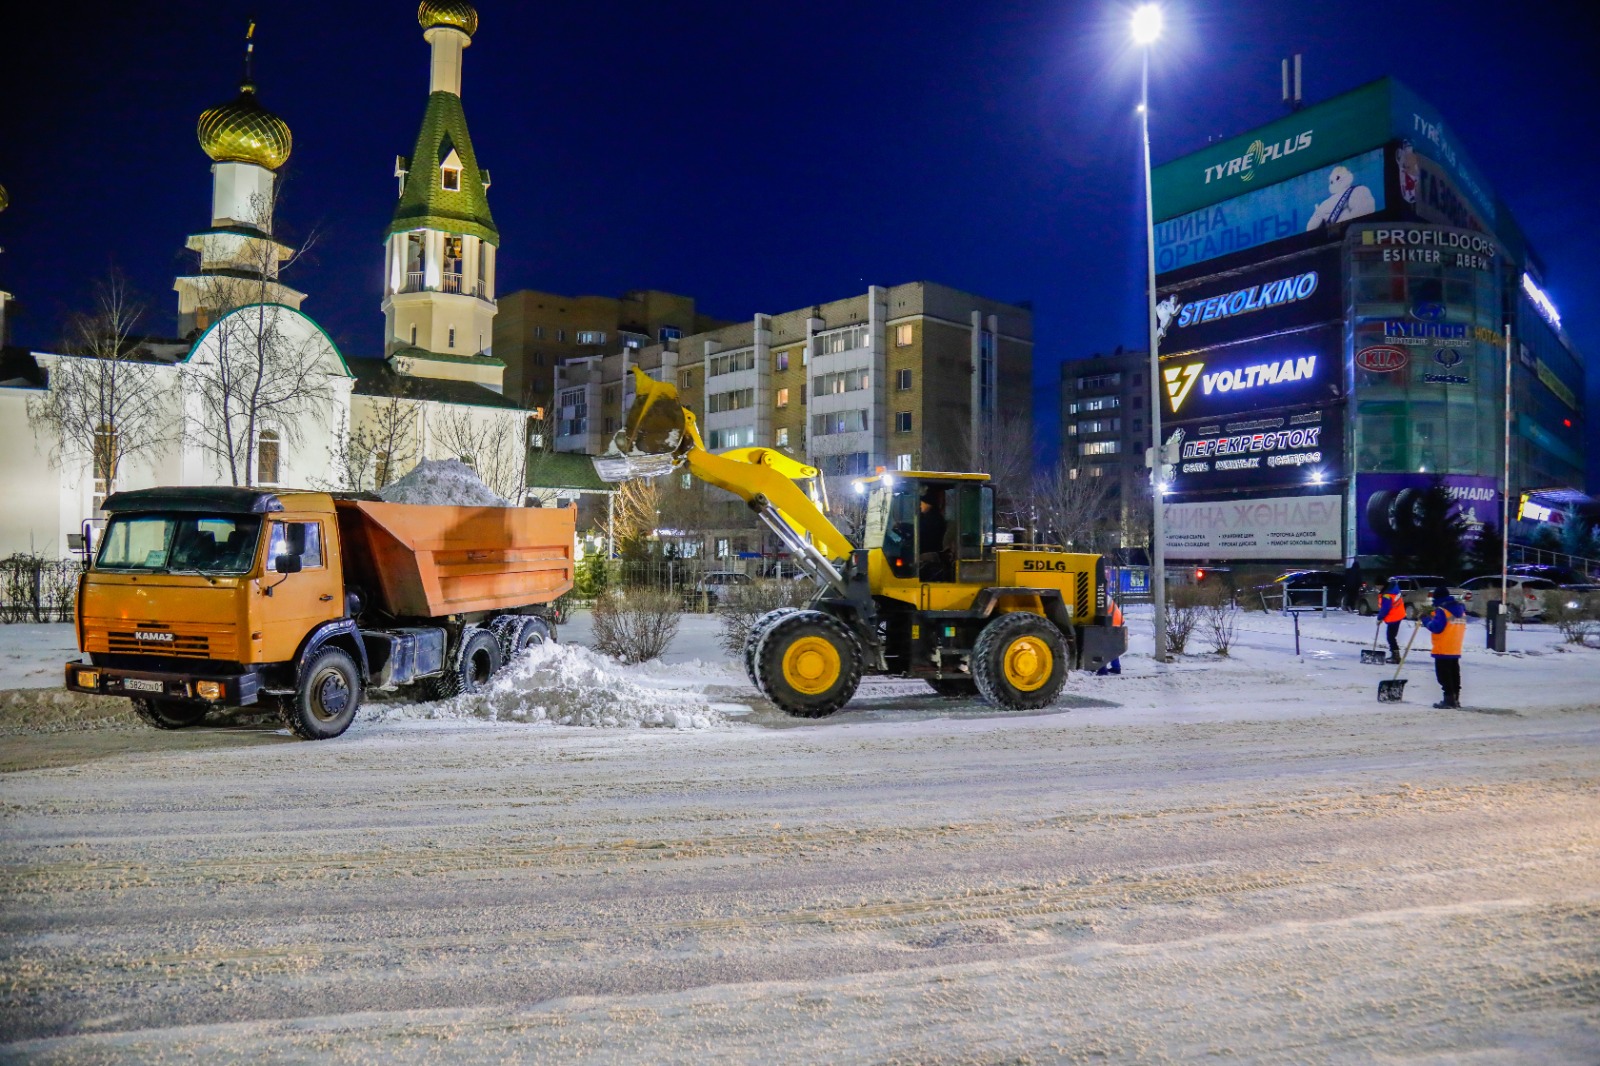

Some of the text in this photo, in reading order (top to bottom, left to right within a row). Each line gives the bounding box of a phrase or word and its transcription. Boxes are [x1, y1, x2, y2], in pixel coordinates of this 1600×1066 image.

[1158, 207, 1228, 247] ШИНА
[1377, 229, 1495, 257] PROFILDOORS
[1383, 249, 1488, 270] ESIKTER ДВЕРИ
[1178, 271, 1319, 328] STEKOLKINO
[1364, 351, 1400, 368] KIA
[1202, 356, 1317, 395] VOLTMAN
[1182, 426, 1322, 459] ПЕРЕКРЕСТОК
[1234, 501, 1336, 528] ЖӨНДЕУ
[1023, 560, 1066, 571] SDLG
[135, 631, 173, 641] KAMAZ
